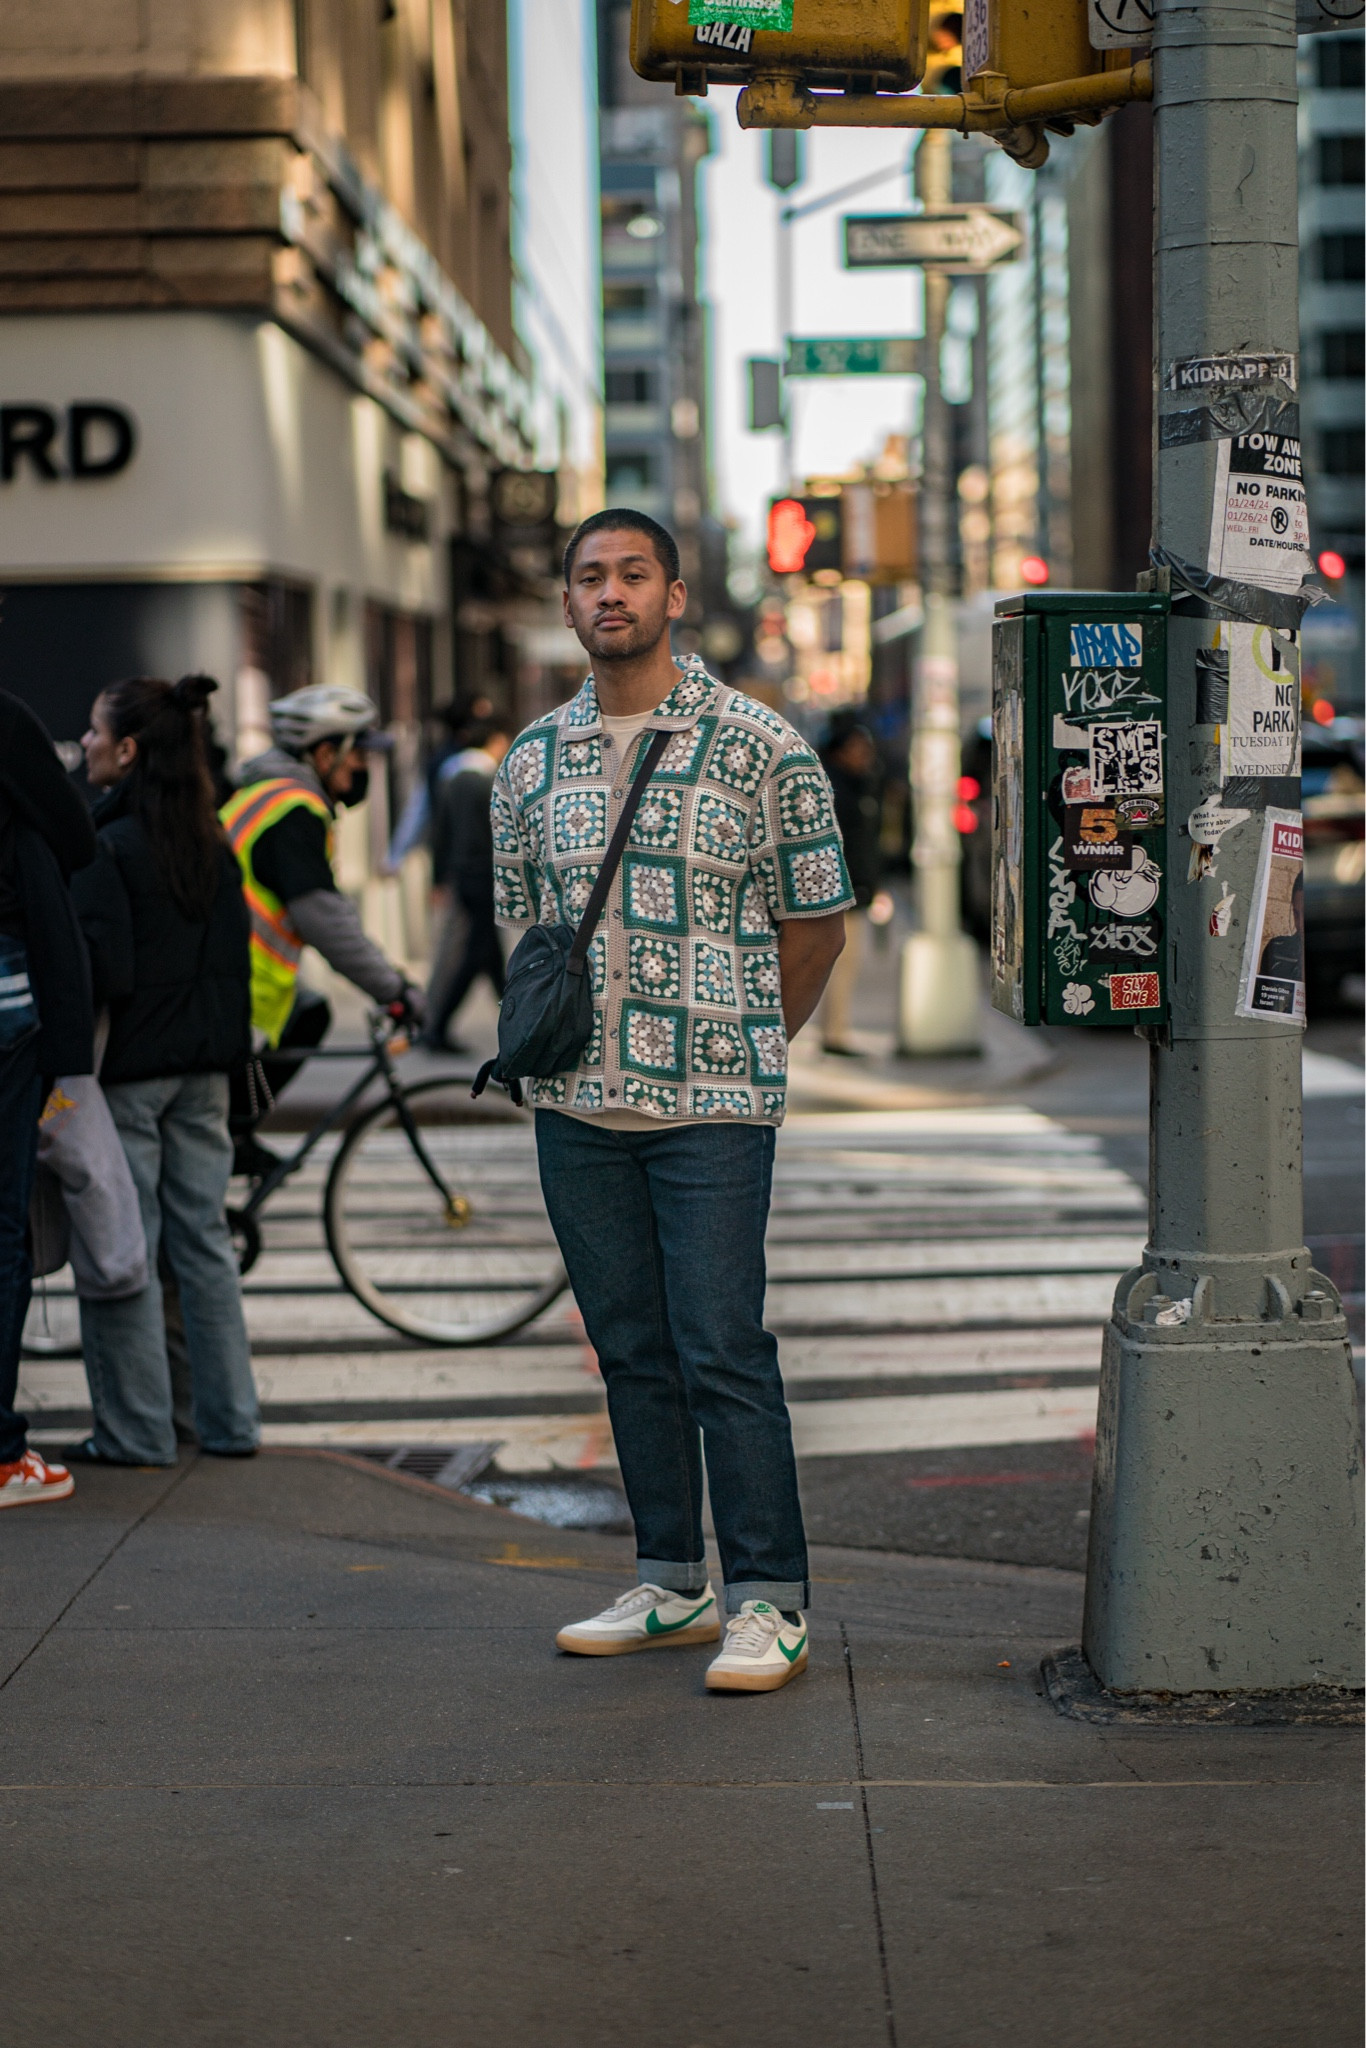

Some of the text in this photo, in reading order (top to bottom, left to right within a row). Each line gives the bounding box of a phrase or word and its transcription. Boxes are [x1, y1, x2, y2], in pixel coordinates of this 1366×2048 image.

[696, 21, 752, 53] GAZA
[0, 402, 135, 481] RD
[1238, 433, 1279, 452] TOW
[1263, 453, 1302, 477] ZONE
[1236, 482, 1260, 496] NO
[1227, 511, 1268, 522] 01/26/24
[1248, 526, 1259, 534] FRI
[1249, 537, 1304, 552] DATE/HOURS
[1230, 736, 1283, 747] TUESDAY
[1234, 764, 1300, 775] WEDNESDY
[1122, 976, 1147, 991] SLY
[1122, 990, 1148, 1006] ONE
